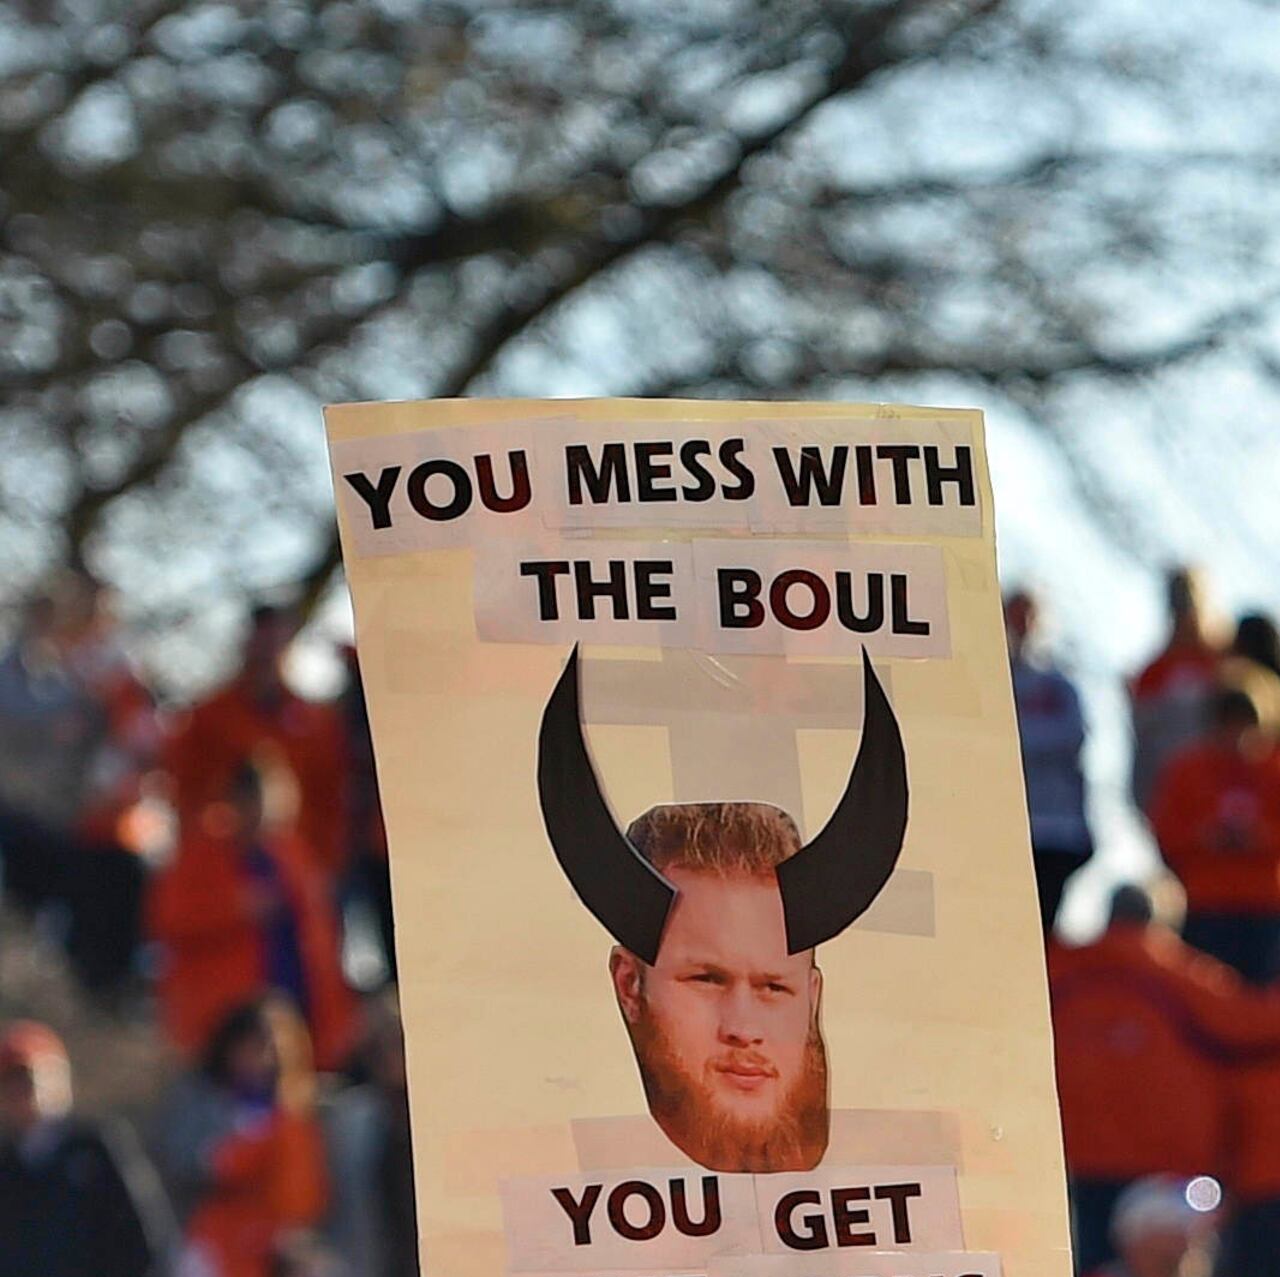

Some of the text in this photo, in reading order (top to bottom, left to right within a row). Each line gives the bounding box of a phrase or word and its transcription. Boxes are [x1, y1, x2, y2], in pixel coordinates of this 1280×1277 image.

[344, 438, 977, 530] YOU MESS WITH
[520, 559, 930, 637] THE BOUL
[551, 1175, 921, 1251] YOU GET
